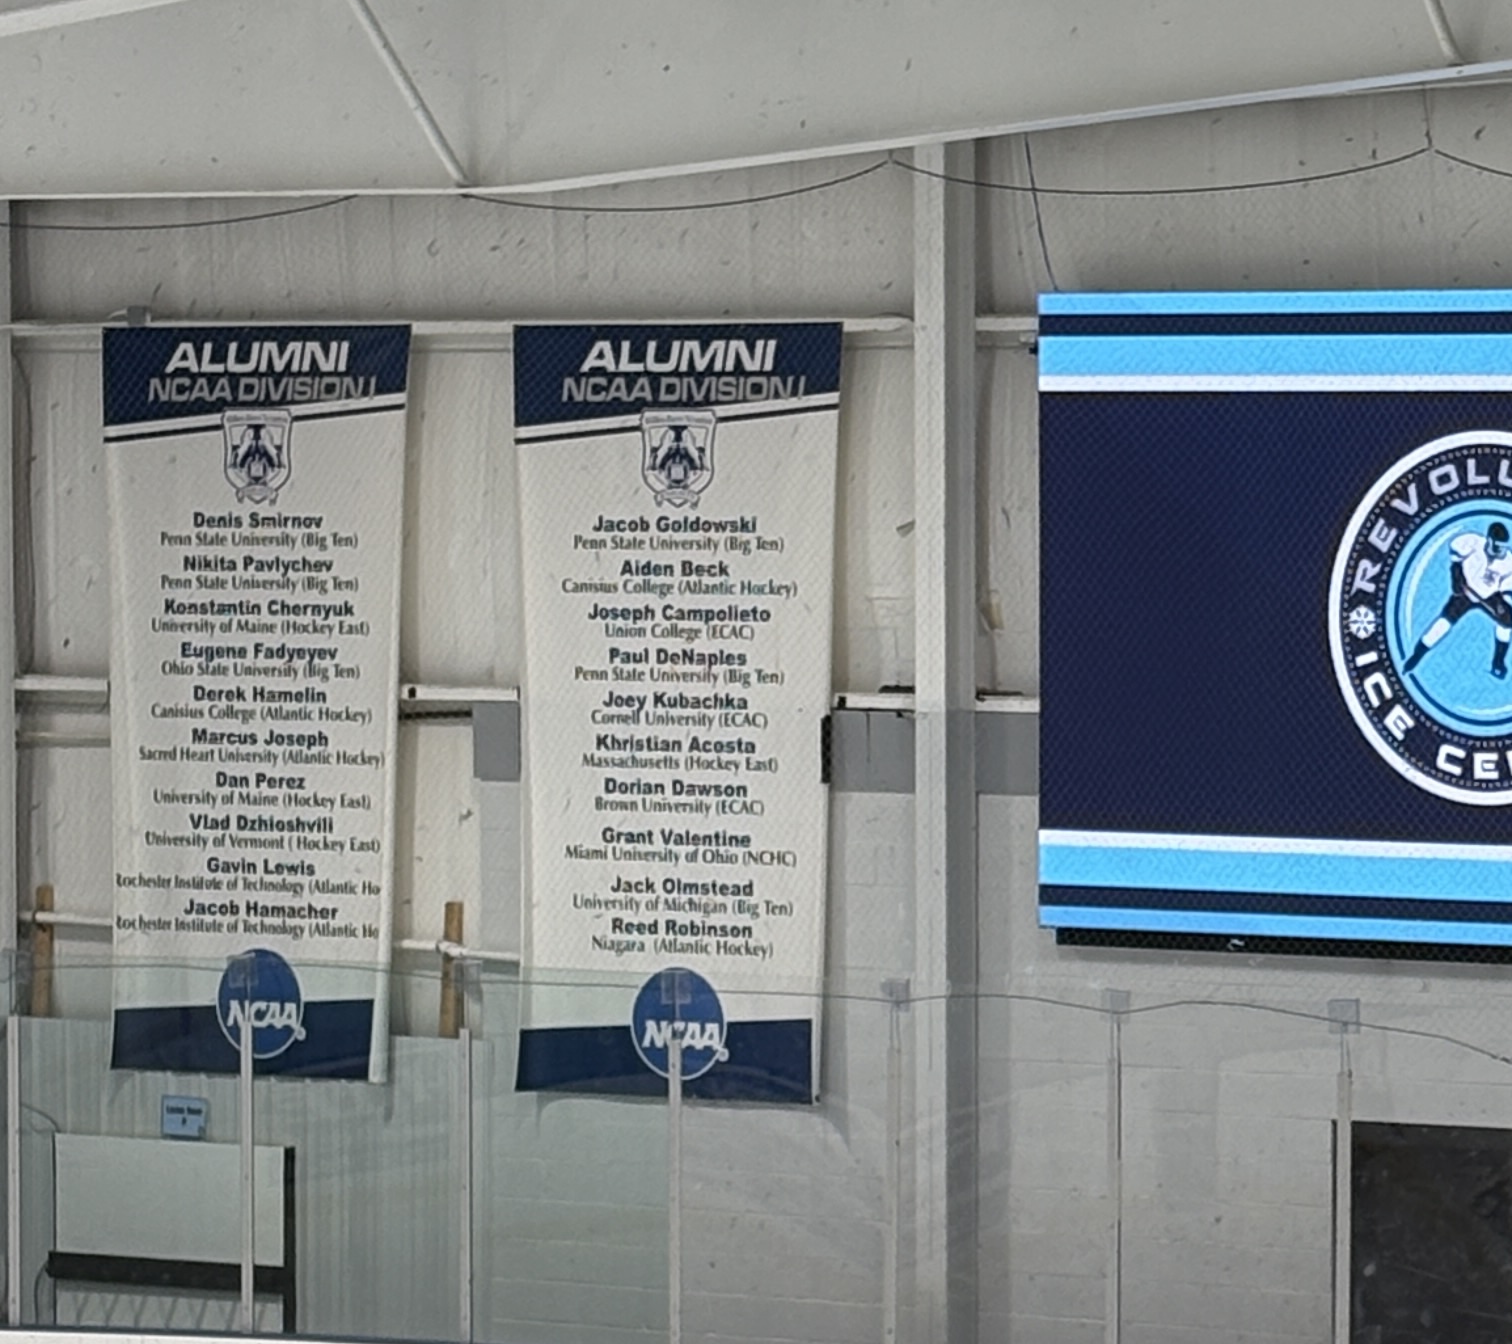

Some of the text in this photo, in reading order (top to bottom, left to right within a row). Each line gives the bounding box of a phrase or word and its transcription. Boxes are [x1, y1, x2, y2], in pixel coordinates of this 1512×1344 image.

[165, 341, 349, 373] ALUMNI
[579, 339, 778, 373] ALUMNI
[149, 376, 376, 402] NCAA DIVISION I
[561, 375, 806, 403] NCAA DIVISION I
[193, 512, 323, 529] Denis Smirnov
[592, 515, 757, 534] Jacob Goldowski
[183, 555, 334, 577] Nikita Pavlychev
[620, 560, 730, 578] Aiden Beck
[164, 599, 355, 620] Konstantin Chernyuk
[588, 603, 771, 626] Joseph Campolieto
[181, 641, 248, 662] Eugene
[608, 647, 747, 671] Paul DeNaples
[193, 685, 327, 704] Derek Hamelin
[602, 691, 748, 713] Joey Kubachka
[1355, 651, 1415, 741] ICE
[192, 728, 328, 750] Marcus Joseph
[595, 733, 756, 754] Khristian Acosta
[216, 771, 306, 790] Dan Perez
[604, 777, 748, 797] Dorian Dawson
[189, 813, 230, 831] Vlad
[602, 827, 751, 847] Grant Valentine
[206, 857, 316, 876] Gavin Lewis
[611, 876, 754, 897] Jack Olmstead
[184, 899, 338, 920] Jacob Hamacher
[611, 918, 752, 939] Reed Robinson
[227, 999, 300, 1029] NCAA
[641, 1019, 722, 1051] NCAA
